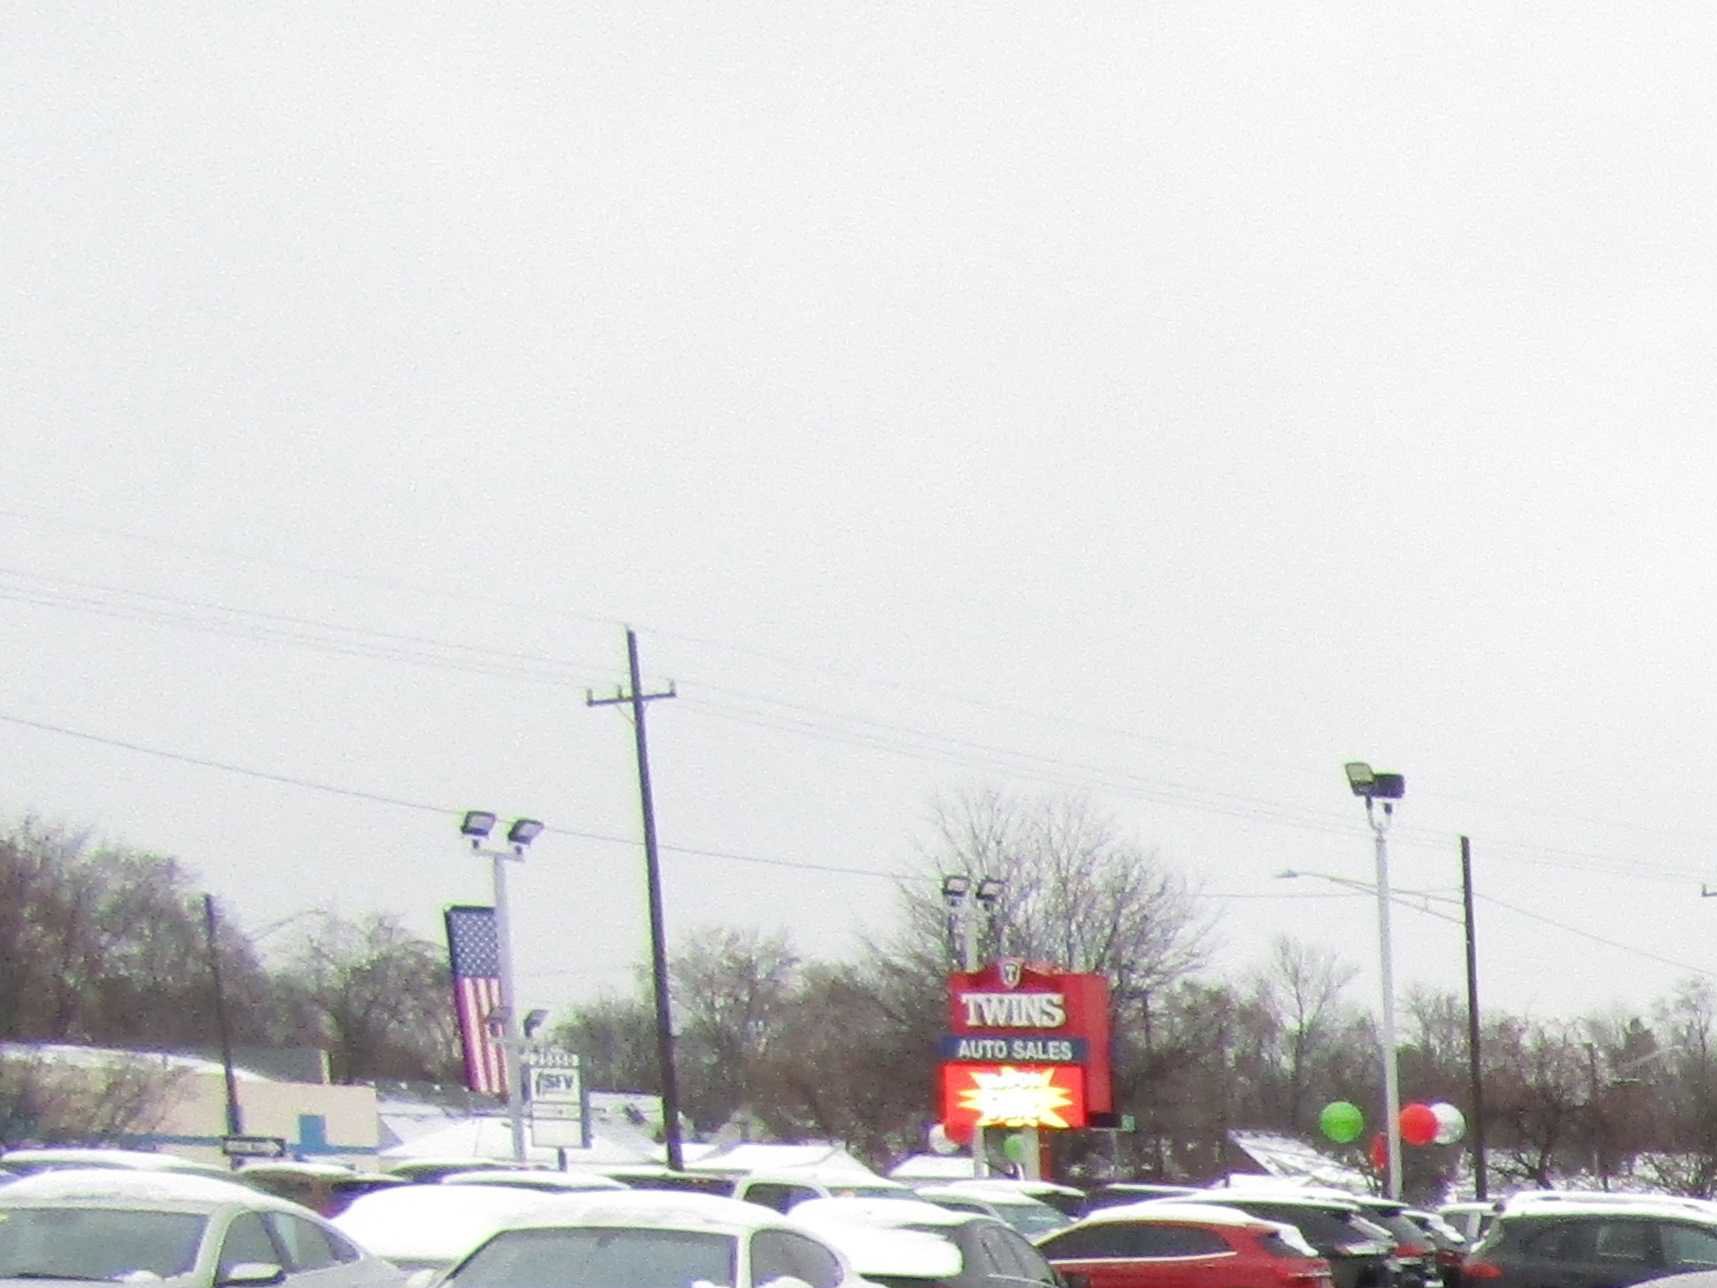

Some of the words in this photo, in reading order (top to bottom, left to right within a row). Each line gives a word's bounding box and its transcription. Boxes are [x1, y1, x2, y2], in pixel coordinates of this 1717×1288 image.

[961, 993, 1067, 1028] TWINS
[957, 1040, 1008, 1060] AUTO
[1012, 1041, 1073, 1061] SALES
